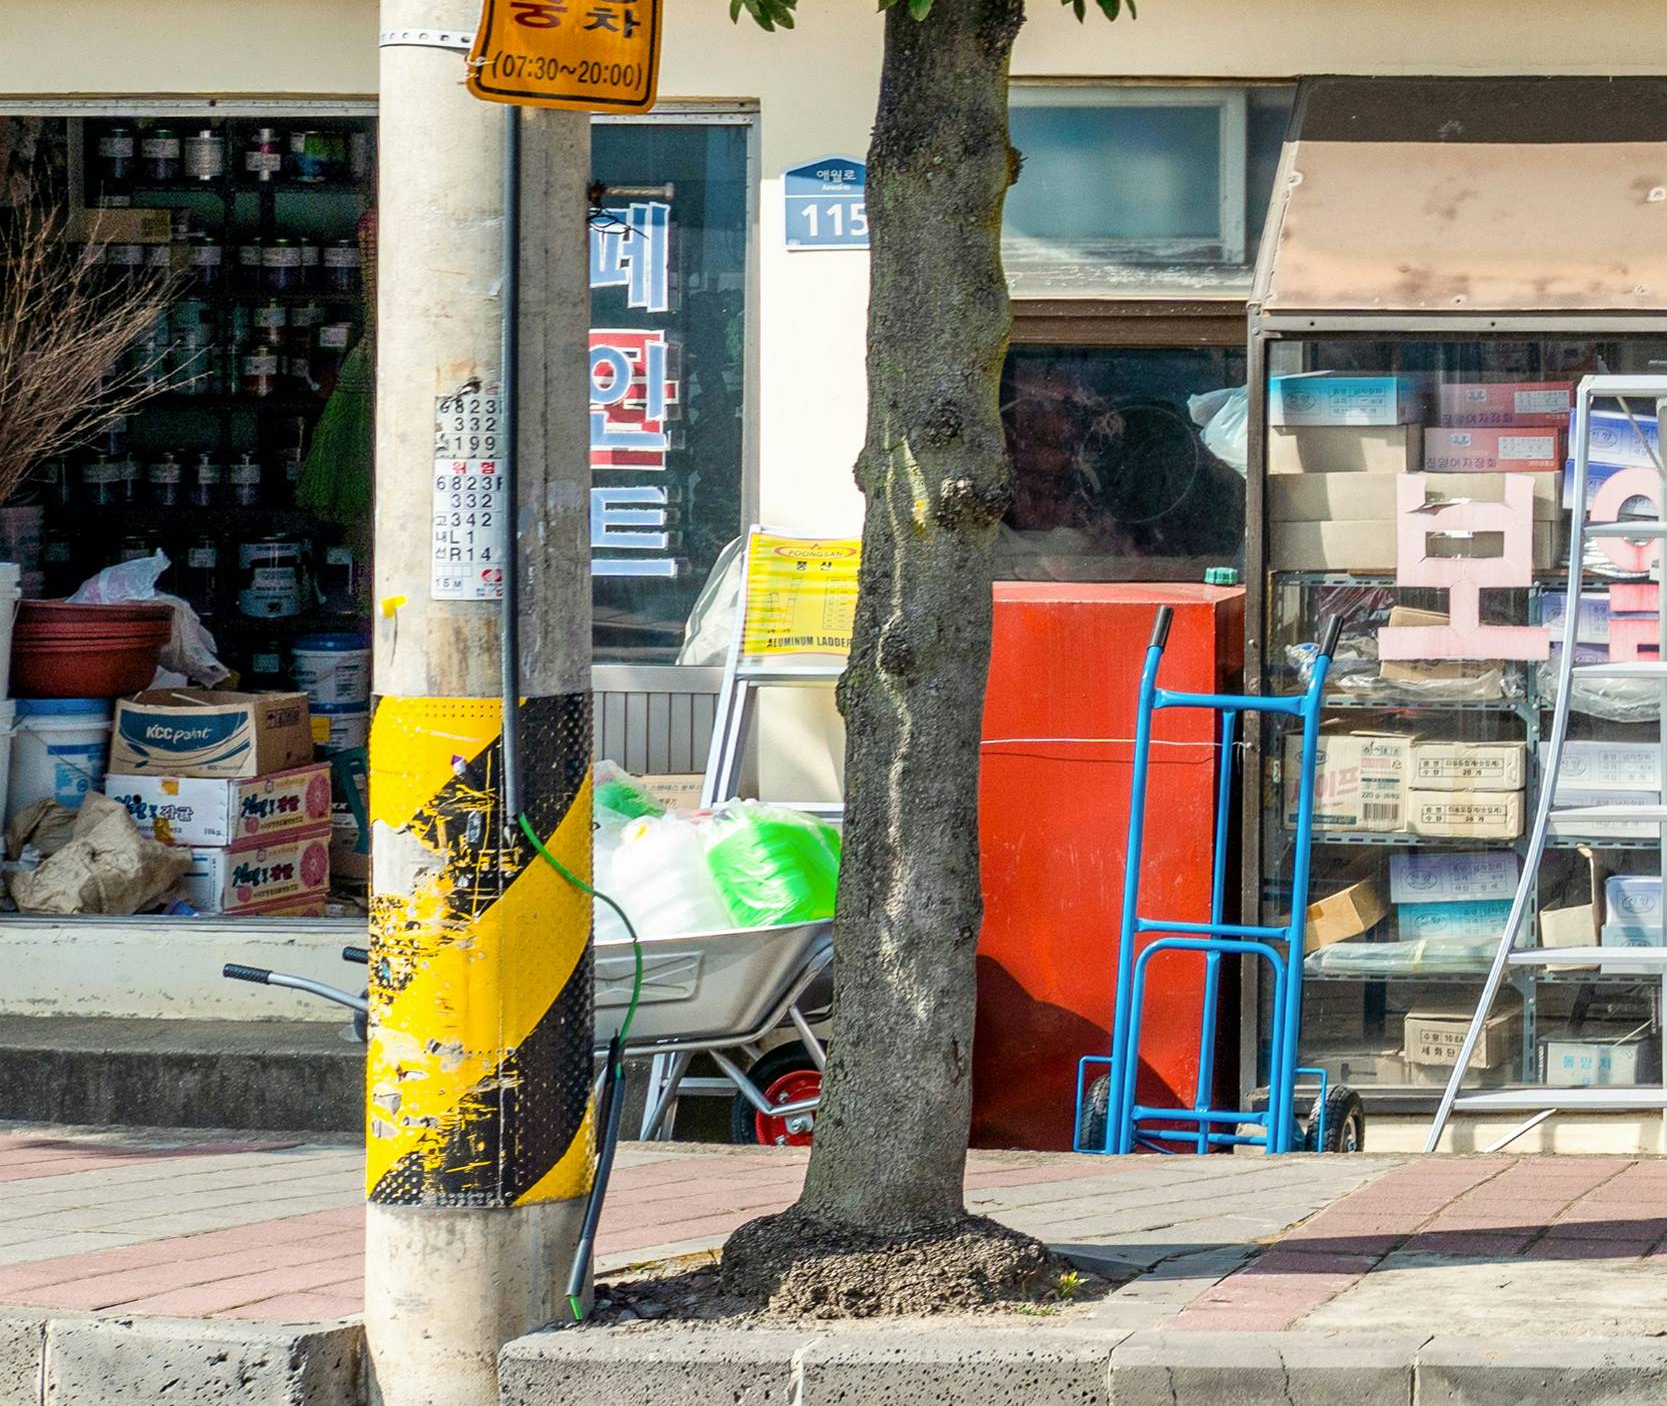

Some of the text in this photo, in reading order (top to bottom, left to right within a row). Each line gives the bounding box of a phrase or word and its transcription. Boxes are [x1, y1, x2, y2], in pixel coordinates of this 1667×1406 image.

[492, 50, 642, 91] (07:30~20:00)
[816, 169, 857, 183] 애월로
[801, 202, 869, 237] 115
[454, 416, 497, 432] 332
[1426, 457, 1497, 469] 진양여자장화
[451, 493, 493, 509] 332
[451, 513, 492, 527] 342
[449, 547, 492, 561] R14
[766, 636, 814, 648] ALUMINUM
[146, 724, 213, 744] KCC paint
[1423, 1032, 1440, 1043] 수량
